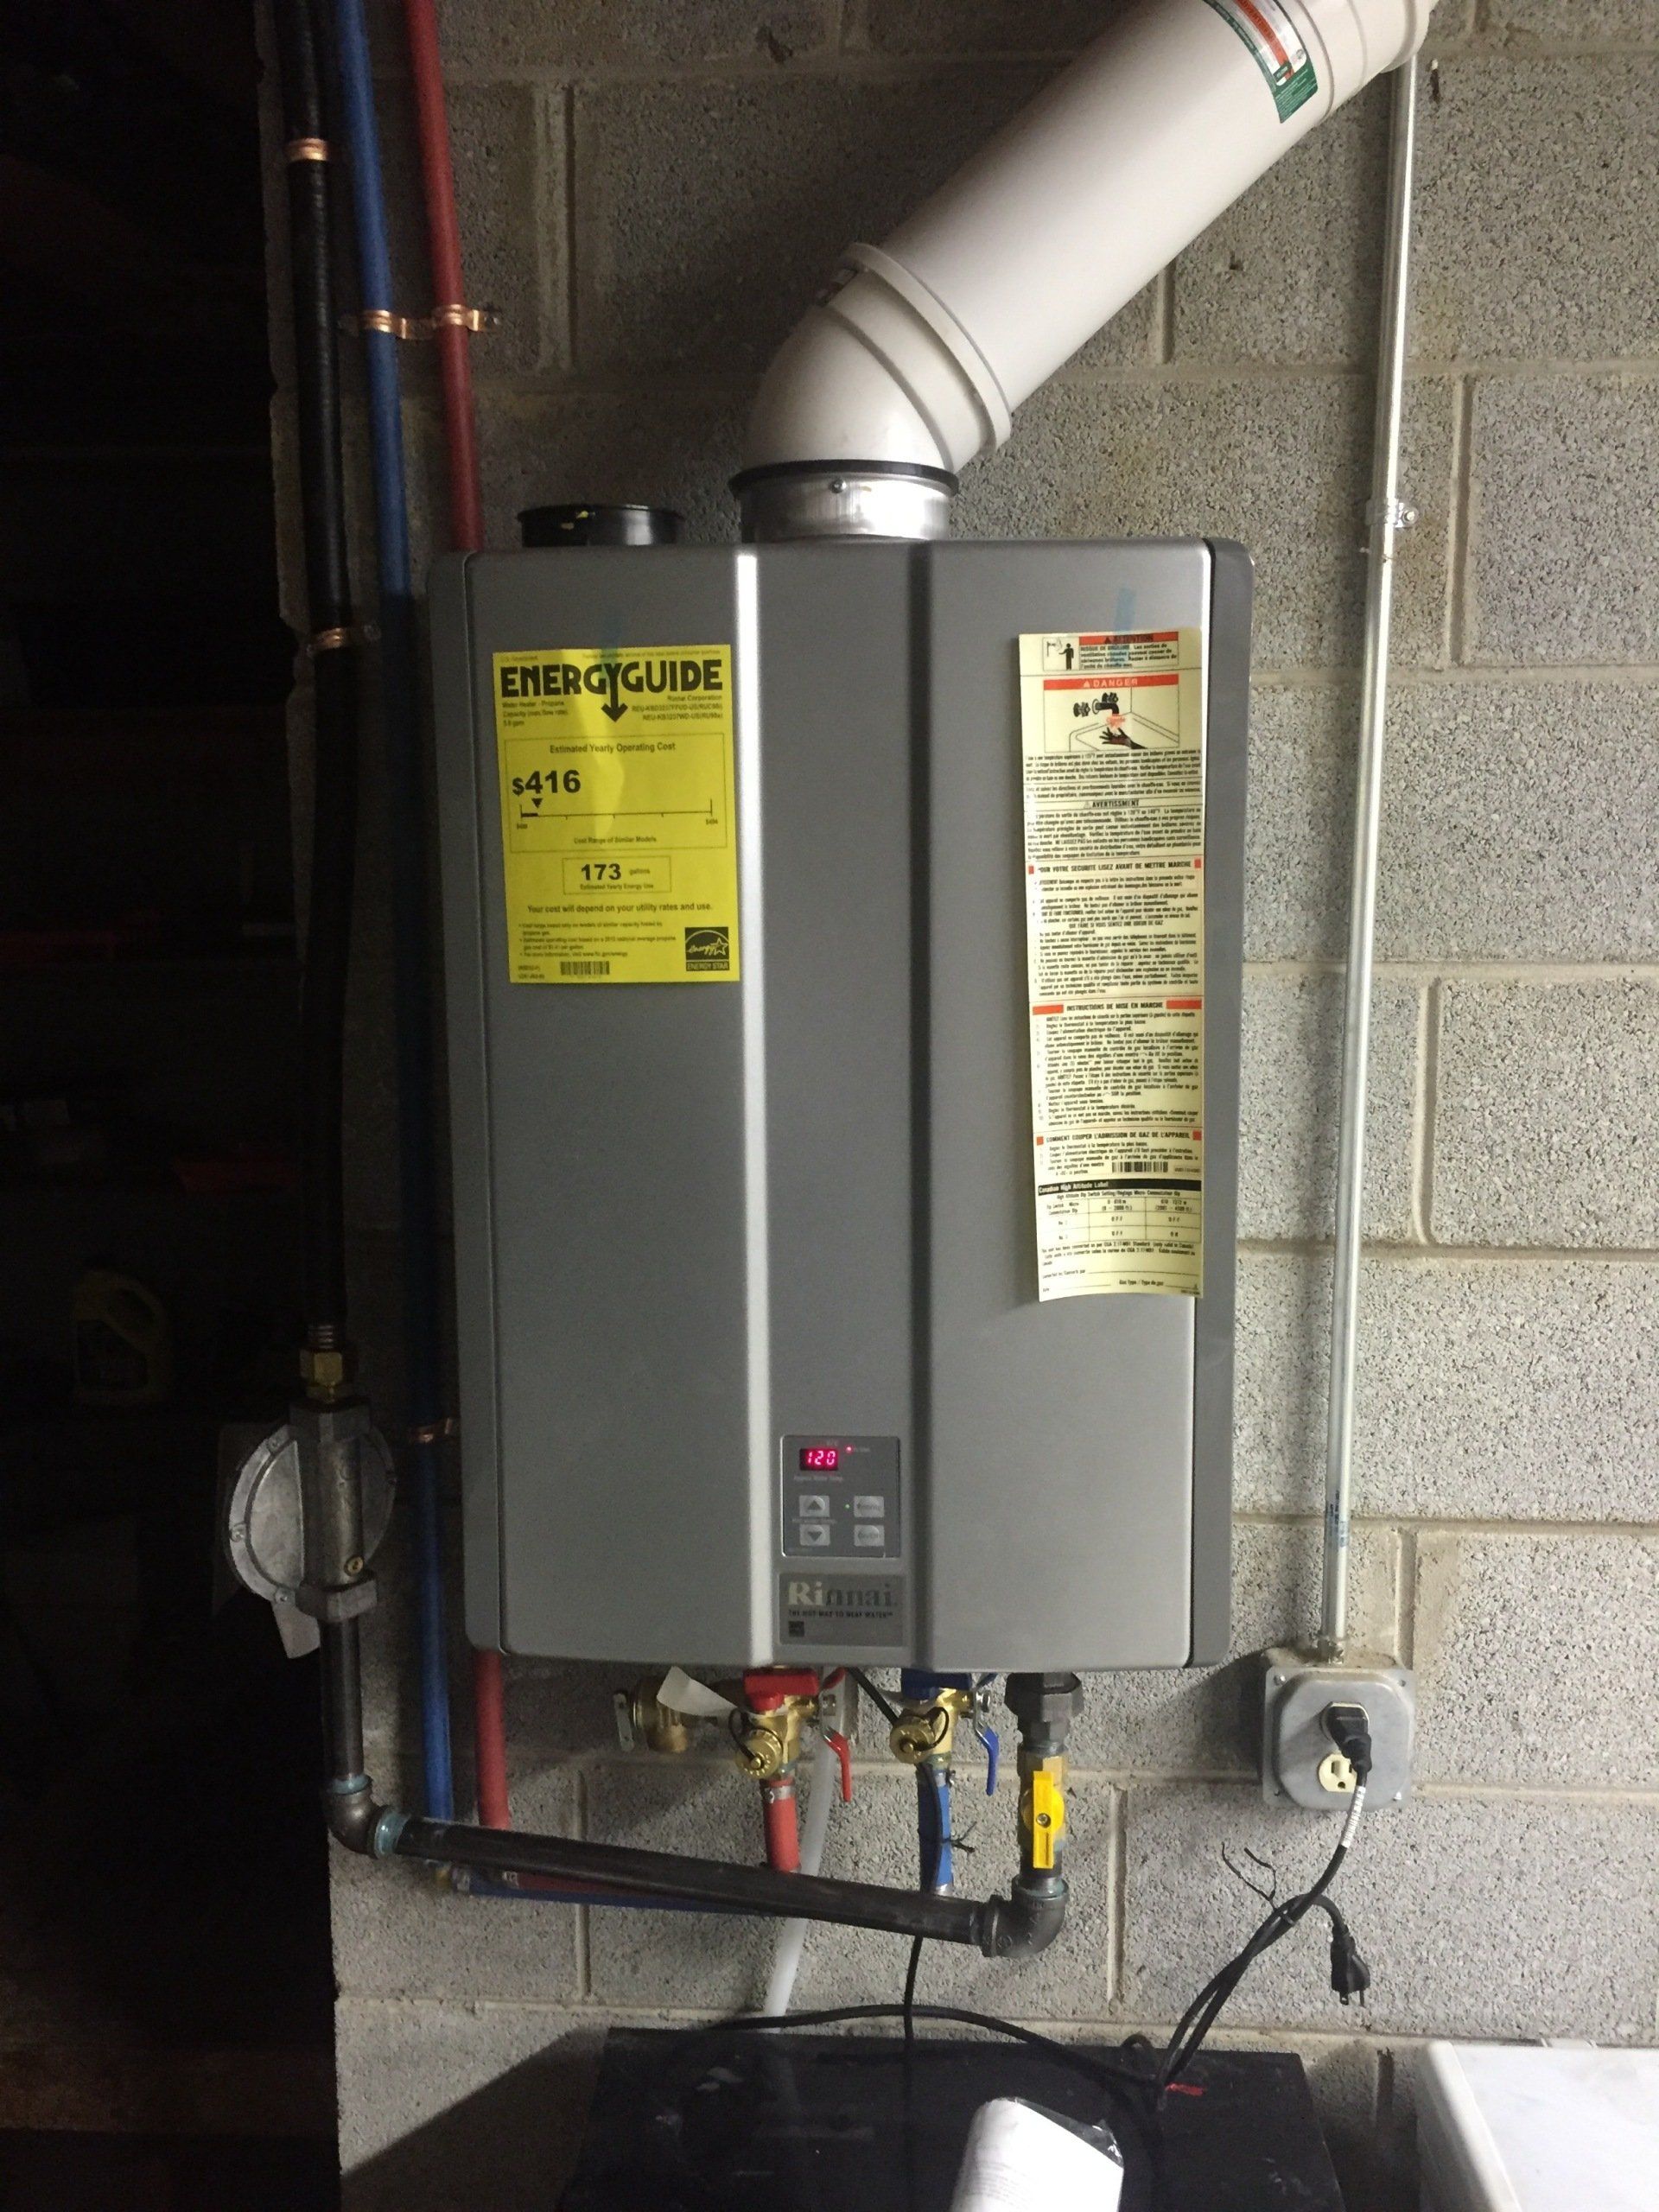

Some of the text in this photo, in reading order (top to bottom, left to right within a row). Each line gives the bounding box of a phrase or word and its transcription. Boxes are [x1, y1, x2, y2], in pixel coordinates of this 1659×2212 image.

[500, 659, 723, 698] ENERGYGUIDE
[1093, 678, 1138, 688] DANGER
[550, 741, 676, 754] Estimated Yearly Operating Cost
[512, 769, 582, 797] $416
[581, 862, 622, 881] 173
[527, 905, 543, 913] Your
[576, 905, 604, 913] depend
[617, 905, 634, 913] your
[636, 903, 657, 912] utility
[808, 1450, 836, 1466] 120
